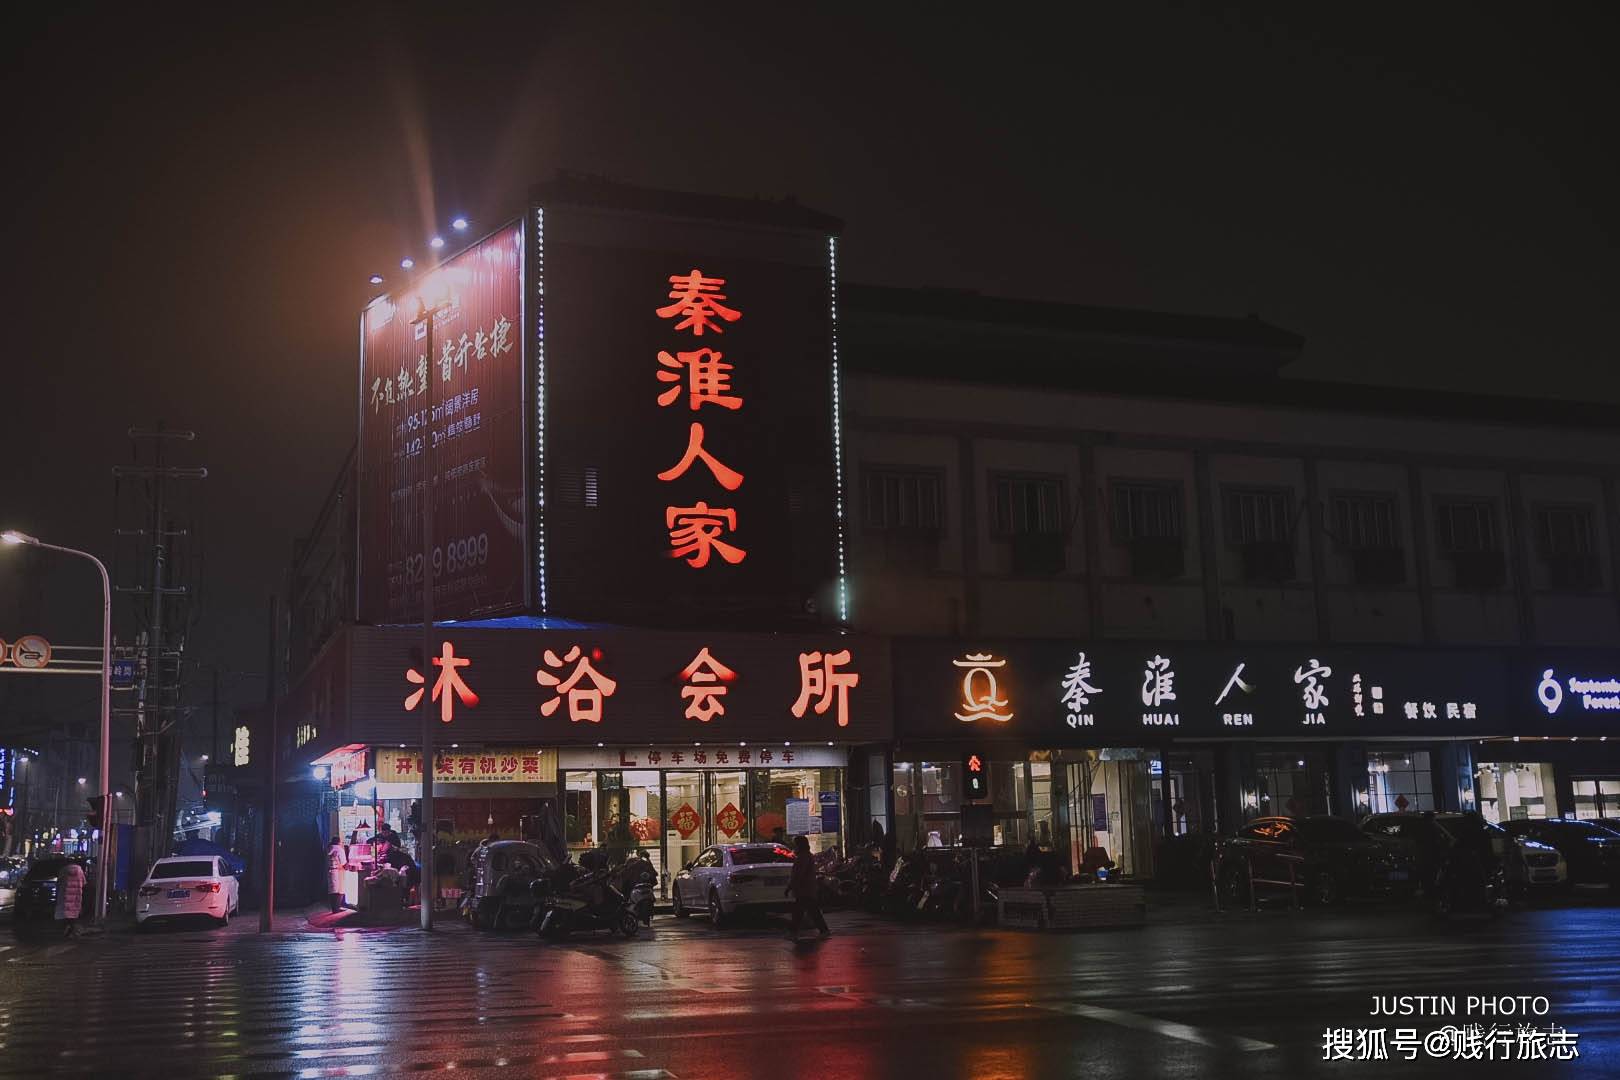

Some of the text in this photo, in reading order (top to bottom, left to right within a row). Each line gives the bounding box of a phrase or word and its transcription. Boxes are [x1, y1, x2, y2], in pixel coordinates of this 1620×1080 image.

[656, 269, 747, 568] 秦淮人家
[406, 547, 442, 584] 829
[447, 533, 488, 573] 8999
[405, 642, 859, 727] 沐浴会所
[1060, 652, 1332, 713] 秦淮人家
[1066, 713, 1326, 728] QIN HUAI REN JIA
[1403, 701, 1477, 720] 餐饮 民宿
[647, 750, 795, 764] 停车场免费停车
